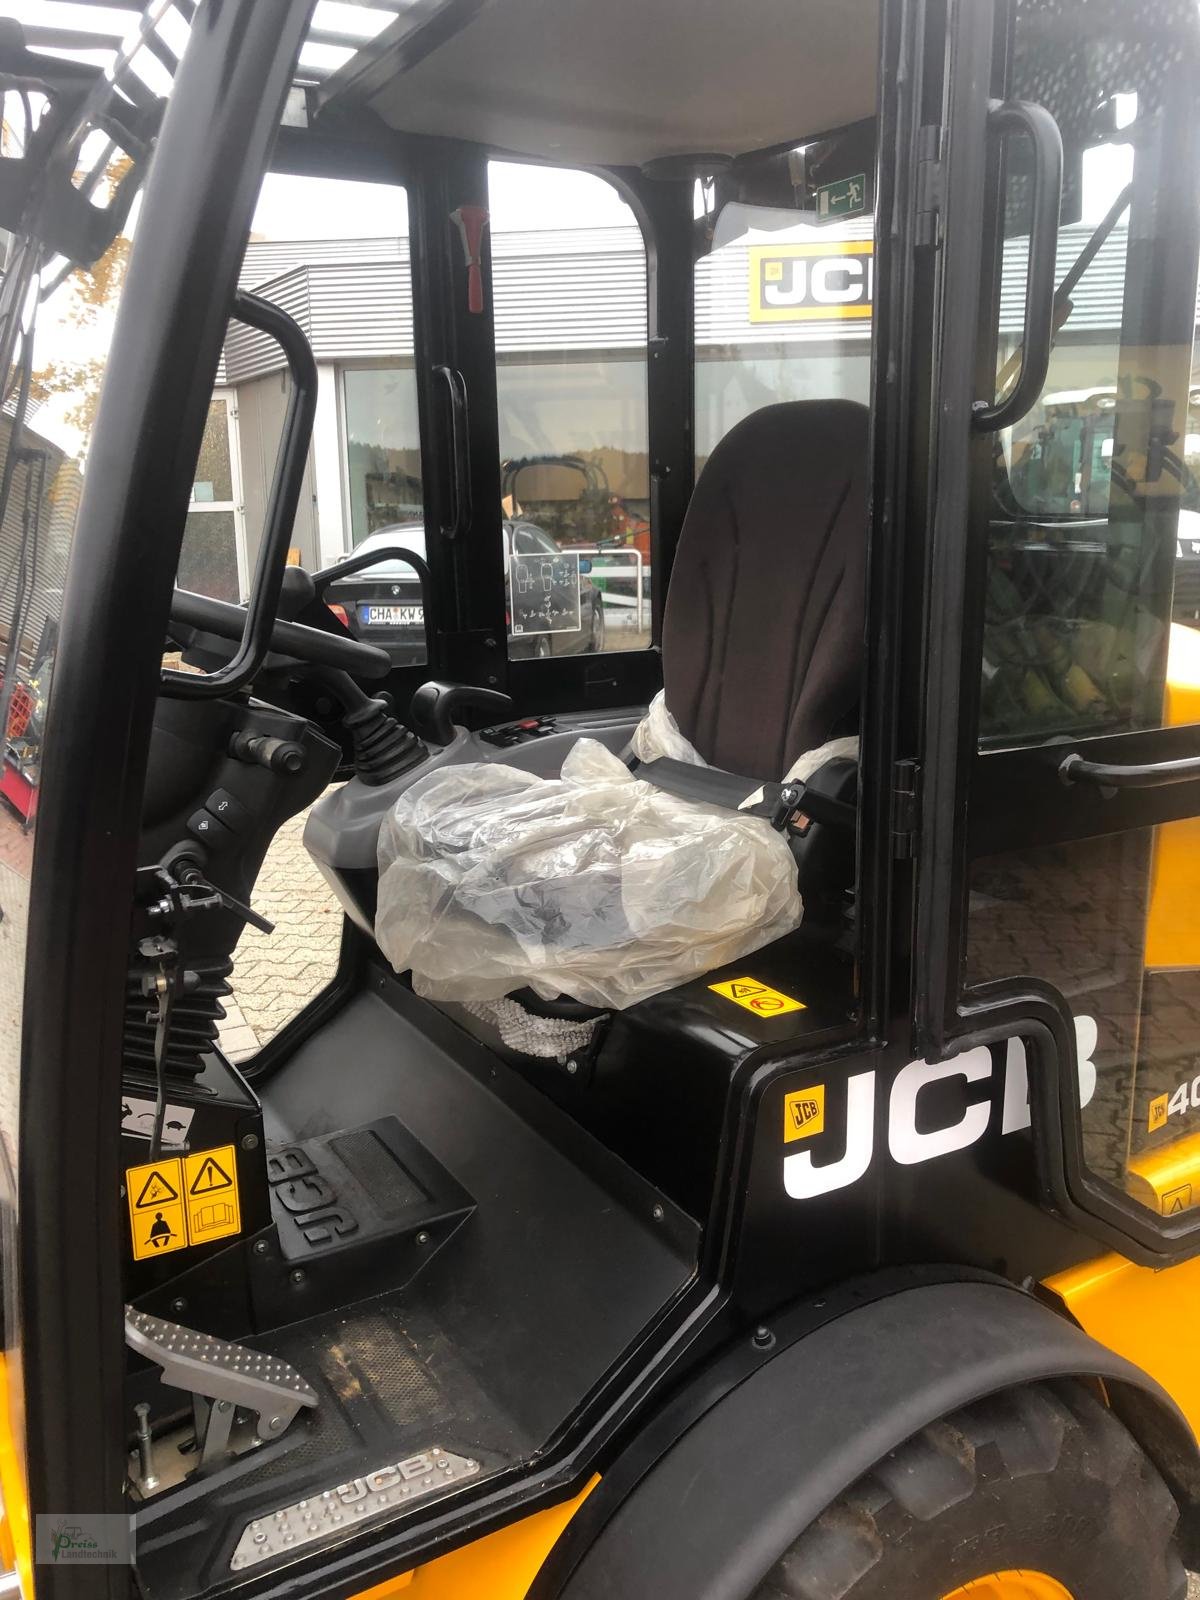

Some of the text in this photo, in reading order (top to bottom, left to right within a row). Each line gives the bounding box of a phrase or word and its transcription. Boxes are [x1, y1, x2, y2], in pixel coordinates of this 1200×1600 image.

[765, 258, 873, 305] JC
[369, 607, 392, 620] CHA
[400, 607, 415, 620] KW
[795, 1101, 818, 1126] JCB
[336, 1454, 434, 1504] JCB
